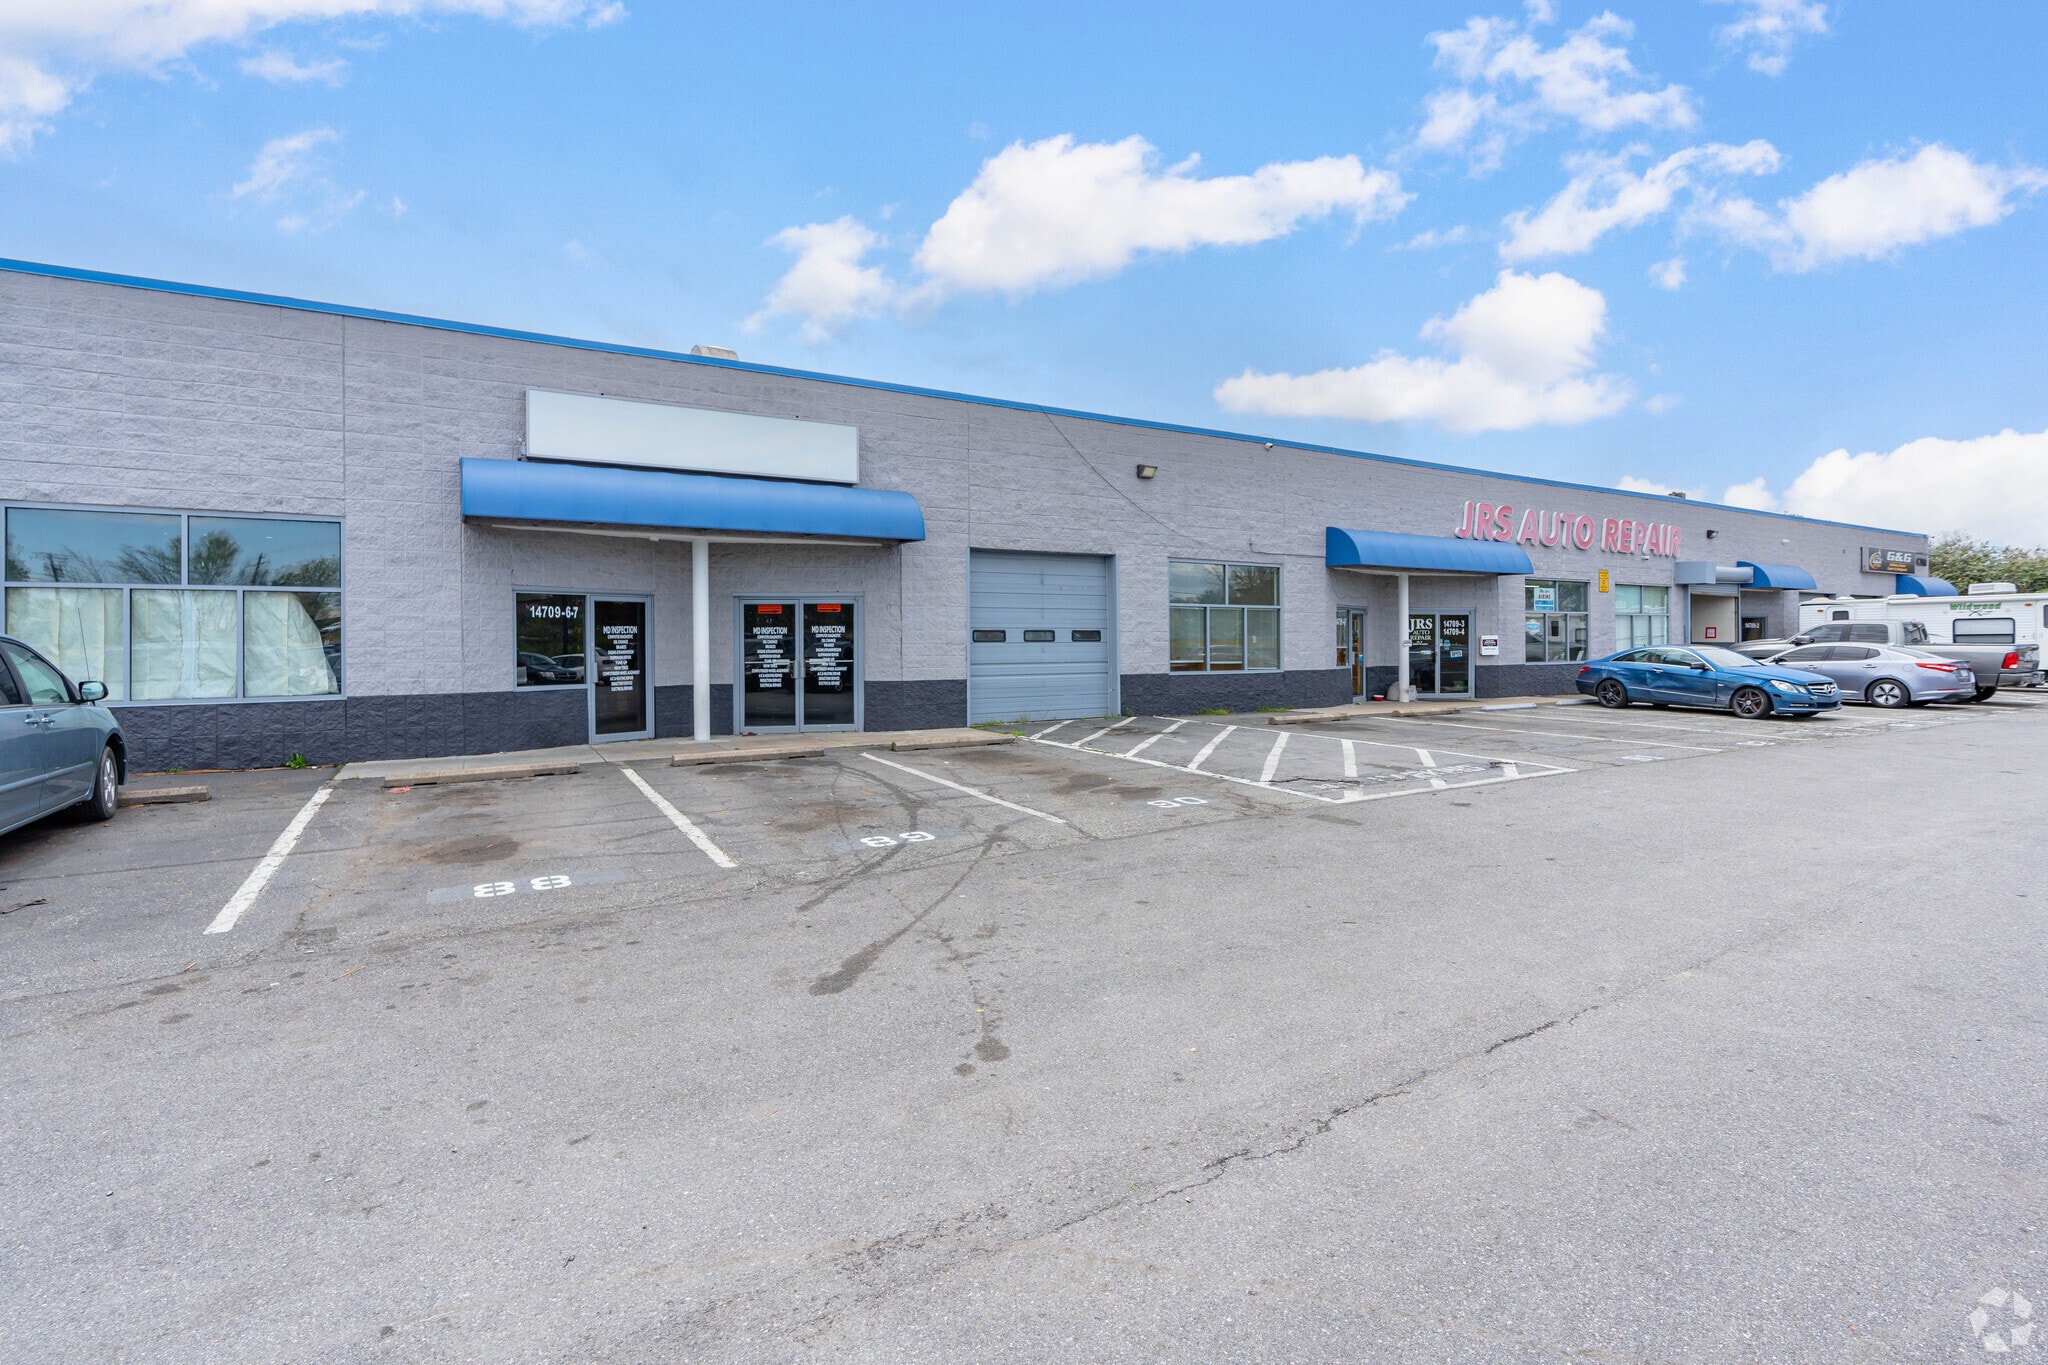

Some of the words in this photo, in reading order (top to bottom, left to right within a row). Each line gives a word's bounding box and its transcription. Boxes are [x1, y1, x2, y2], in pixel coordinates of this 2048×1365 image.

[1455, 500, 1512, 541] JRS
[1516, 508, 1595, 549] AUTO
[1601, 517, 1682, 558] REPAIR
[530, 605, 579, 619] 14709-6-7
[1949, 602, 2002, 610] Wildwood
[611, 626, 638, 634] INSPECTION
[1408, 618, 1433, 632] JRS
[1443, 620, 1465, 628] 14709-3
[1443, 628, 1465, 636] 14709-4
[1148, 797, 1208, 808] 90
[861, 831, 936, 847] 89
[474, 875, 572, 898] 88
